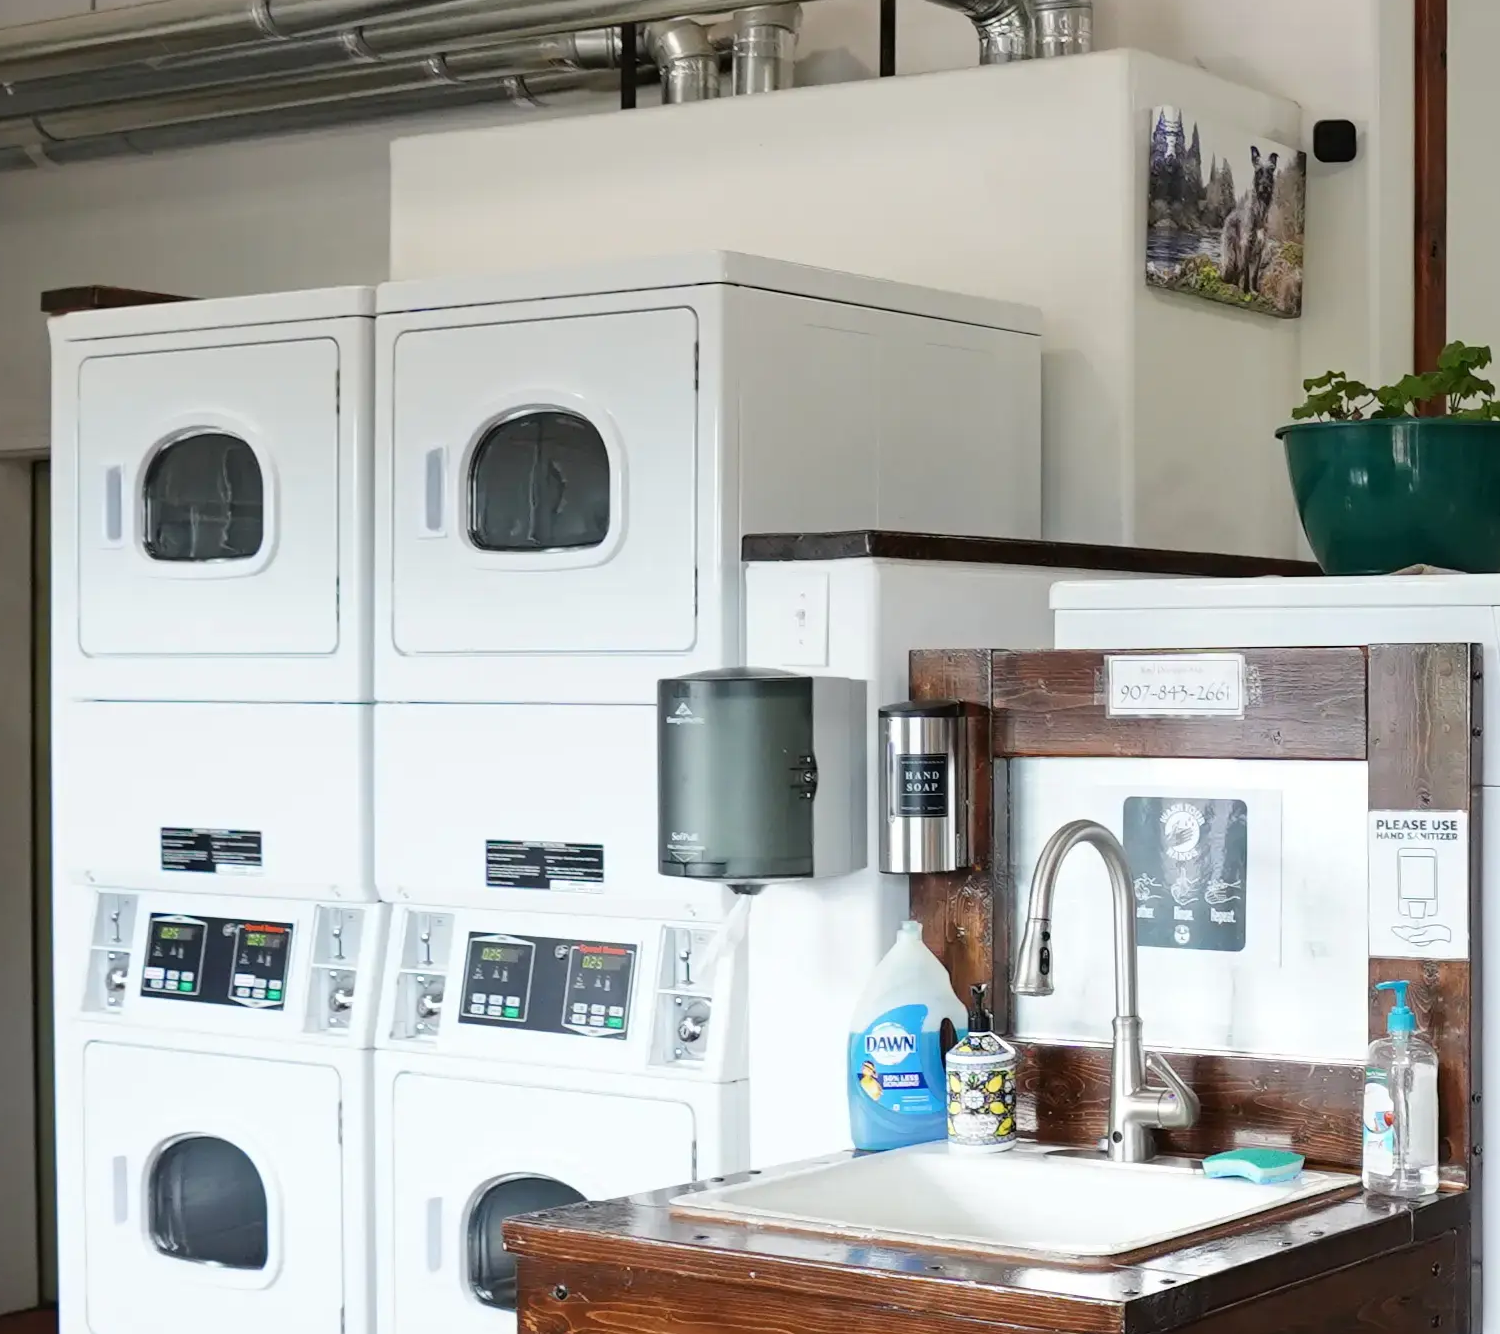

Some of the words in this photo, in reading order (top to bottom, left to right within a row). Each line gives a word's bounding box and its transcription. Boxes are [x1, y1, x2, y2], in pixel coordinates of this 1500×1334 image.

[1121, 681, 1230, 703] 907-843-2661
[905, 771, 940, 780] HAND
[906, 783, 938, 791] SOAP
[1160, 804, 1183, 823] WASH
[1184, 803, 1205, 826] YOUR
[1376, 820, 1427, 830] PLEASE
[1432, 821, 1458, 830] USE
[1166, 847, 1199, 861] HANDS
[866, 1036, 914, 1052] DAWN
[900, 1074, 919, 1082] LESS
